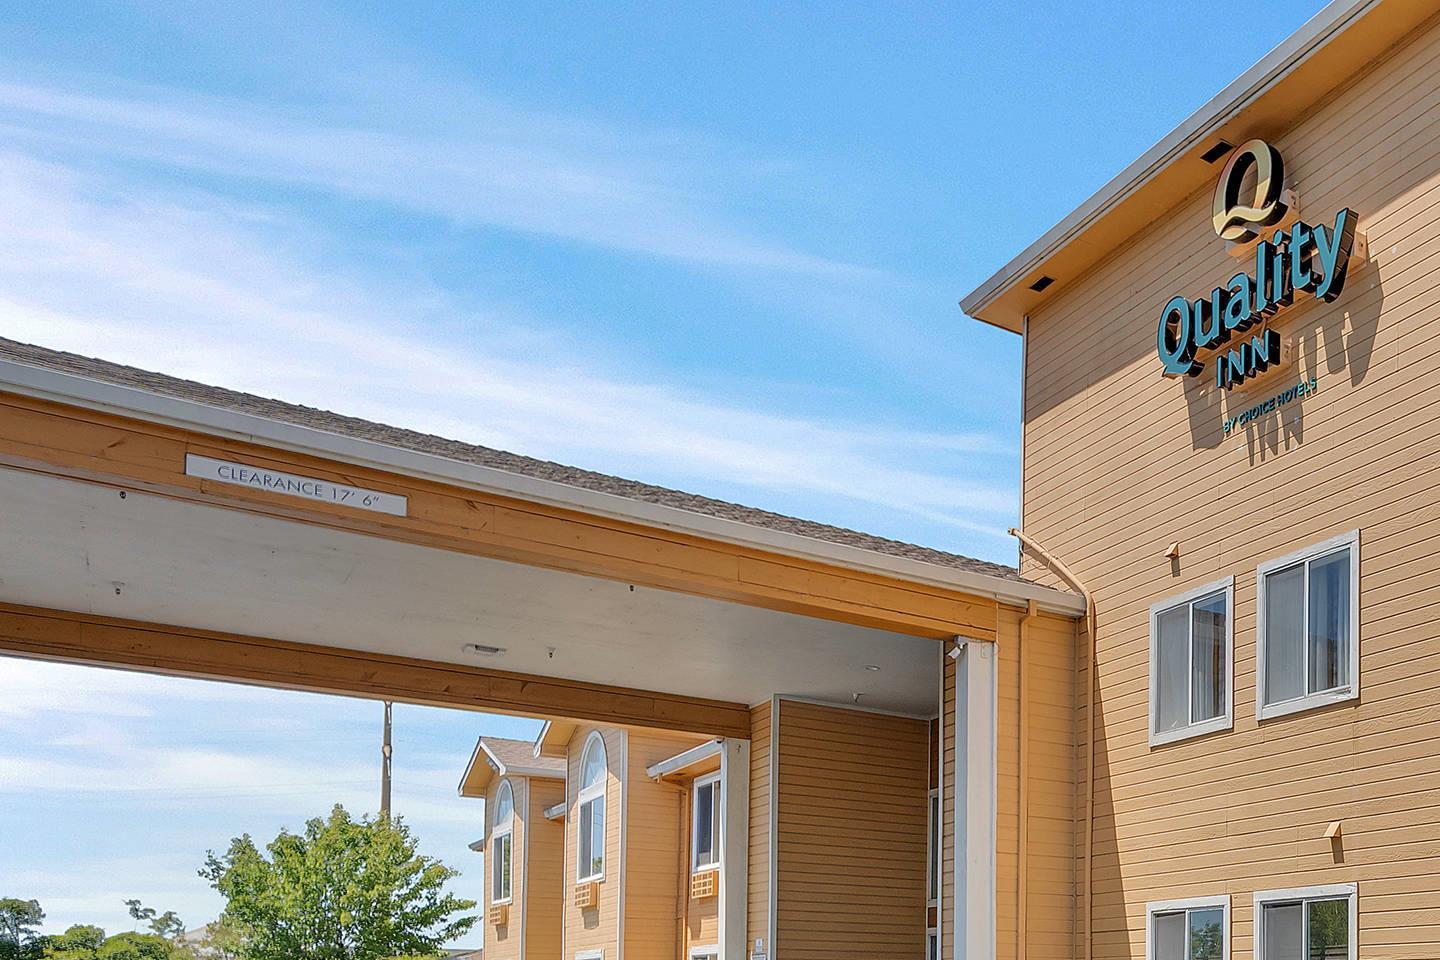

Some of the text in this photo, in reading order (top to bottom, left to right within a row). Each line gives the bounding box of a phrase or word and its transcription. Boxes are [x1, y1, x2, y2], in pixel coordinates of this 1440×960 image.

[1212, 138, 1282, 242] Q
[1157, 207, 1353, 376] Quality
[1216, 328, 1273, 389] INN
[1223, 376, 1318, 433] BY CHOICE HOTELS
[217, 465, 380, 507] CLEARANCE 17' 6"
